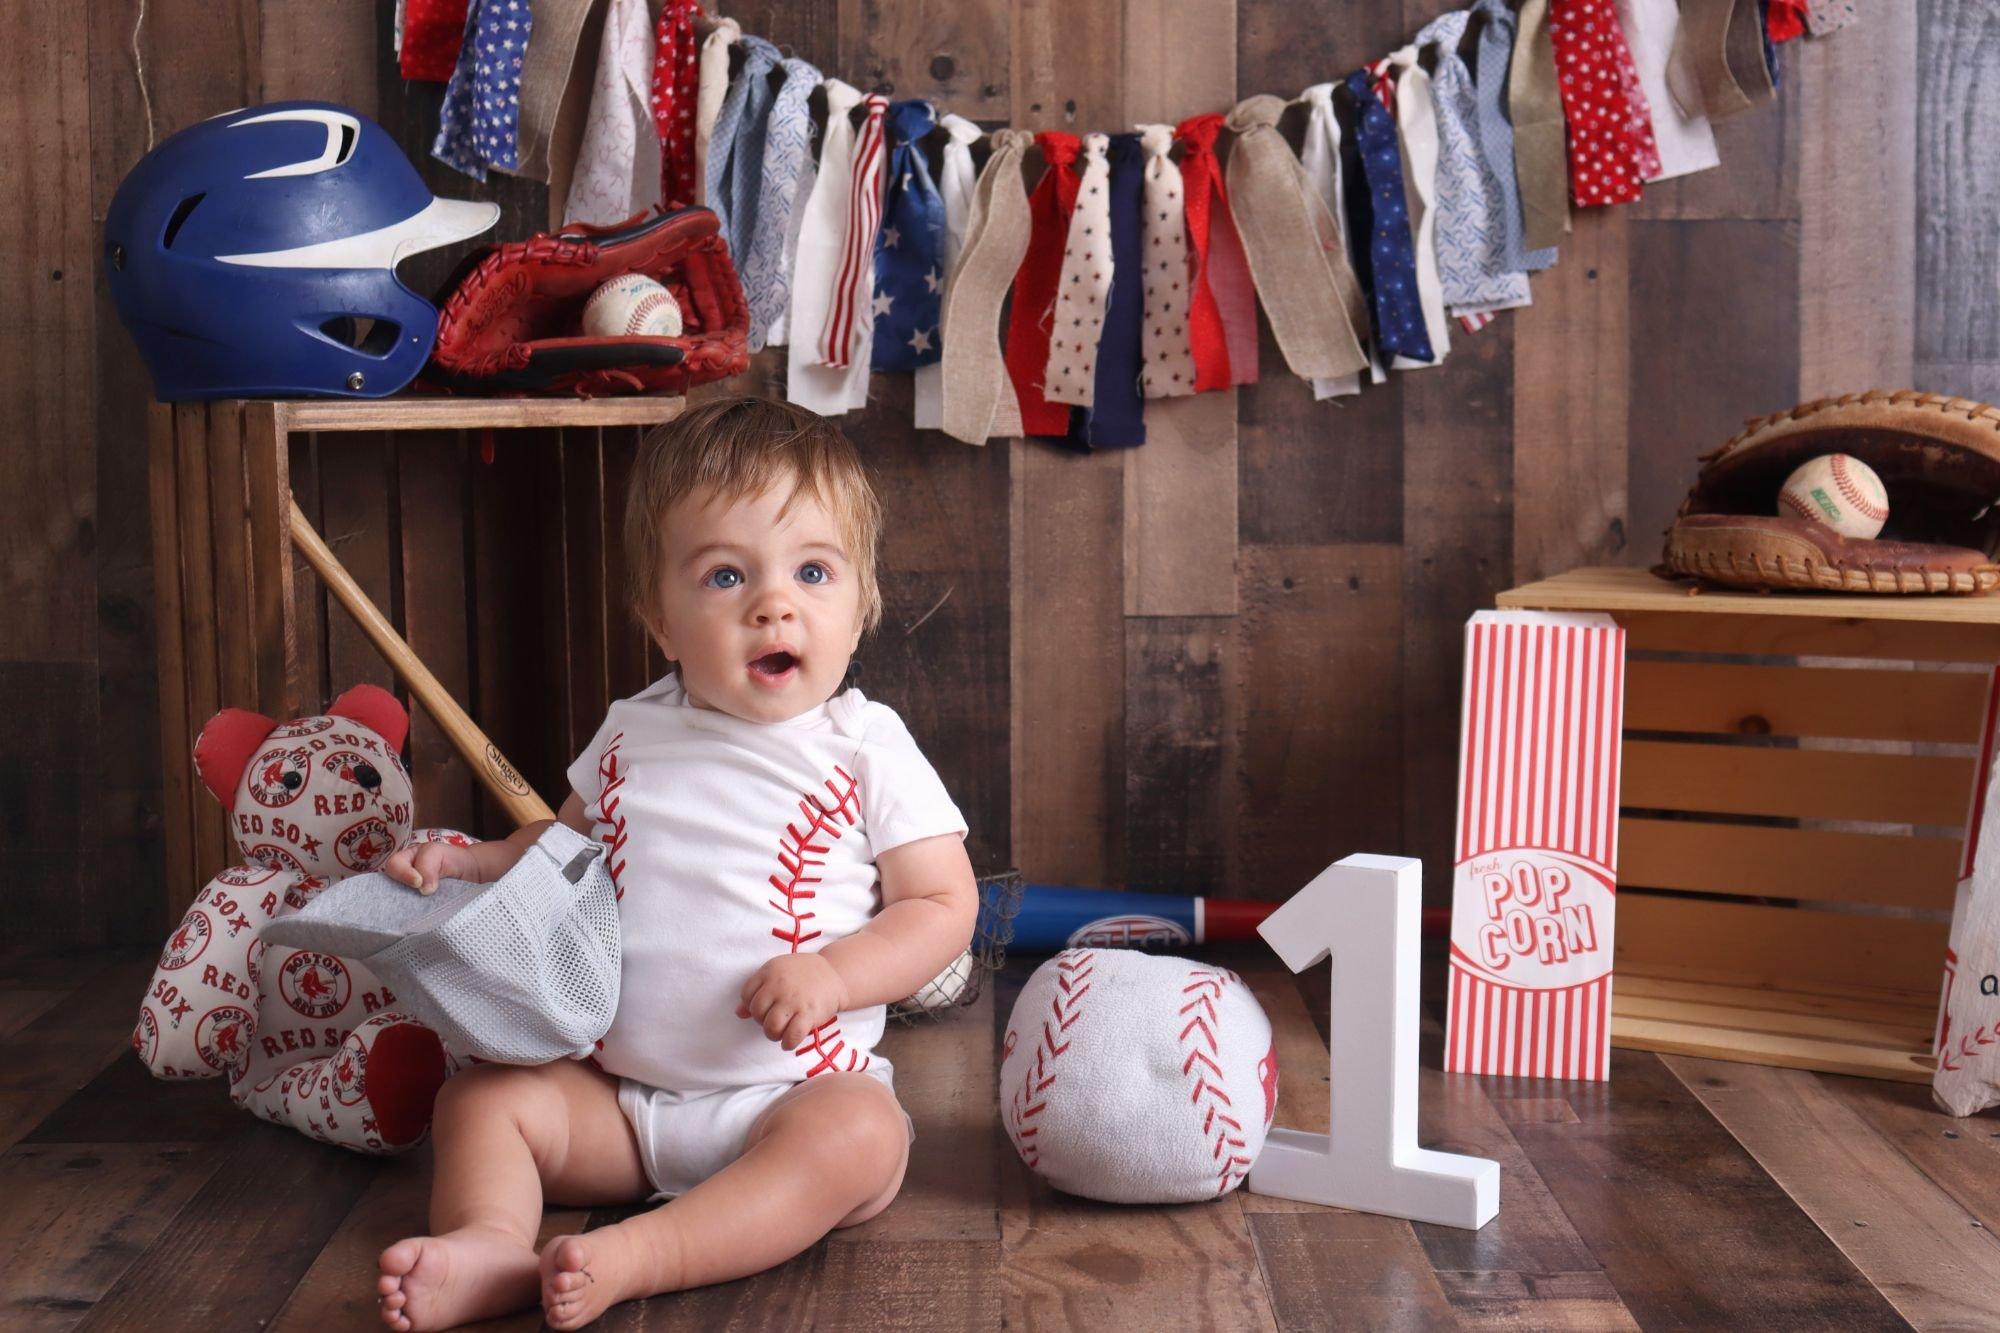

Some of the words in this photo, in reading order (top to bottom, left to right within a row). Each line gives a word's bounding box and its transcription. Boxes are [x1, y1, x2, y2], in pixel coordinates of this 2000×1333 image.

[263, 750, 307, 769] BOSTON
[329, 733, 381, 757] SOX
[489, 747, 524, 790] Slugger
[314, 792, 365, 816] RED
[382, 801, 410, 825] SOX
[236, 813, 264, 835] ED
[272, 817, 323, 857] SOX
[1469, 858, 1502, 881] fresh
[1483, 860, 1572, 921] POP
[209, 891, 252, 934] SOX
[1480, 904, 1598, 970] CORN
[202, 964, 250, 1000] RED
[286, 953, 342, 977] BOSTON
[152, 979, 194, 1024] SOX
[291, 997, 316, 1017] RED
[260, 1028, 316, 1059] RED
[1249, 853, 1500, 1231] 1
